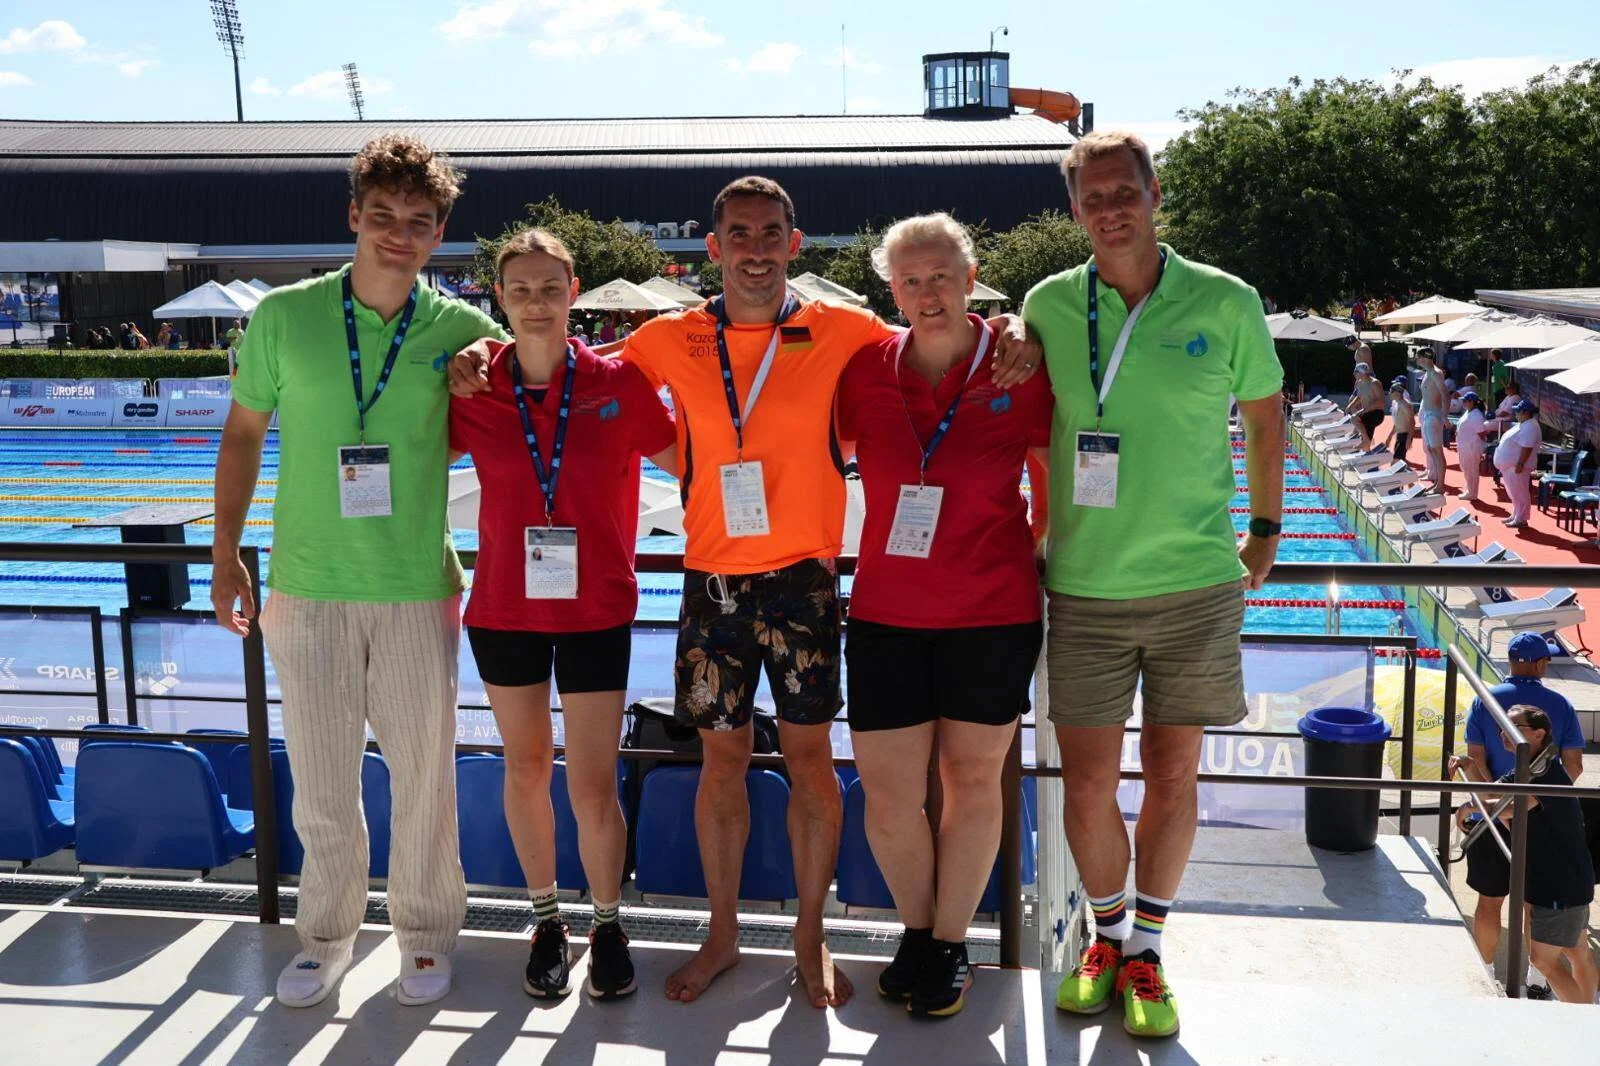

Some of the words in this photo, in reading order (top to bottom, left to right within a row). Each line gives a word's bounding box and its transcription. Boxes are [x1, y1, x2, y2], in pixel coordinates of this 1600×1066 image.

[687, 332, 716, 343] Kaza
[45, 385, 95, 396] EUROPEAN
[175, 409, 215, 417] SHARP
[1492, 587, 1502, 601] 8
